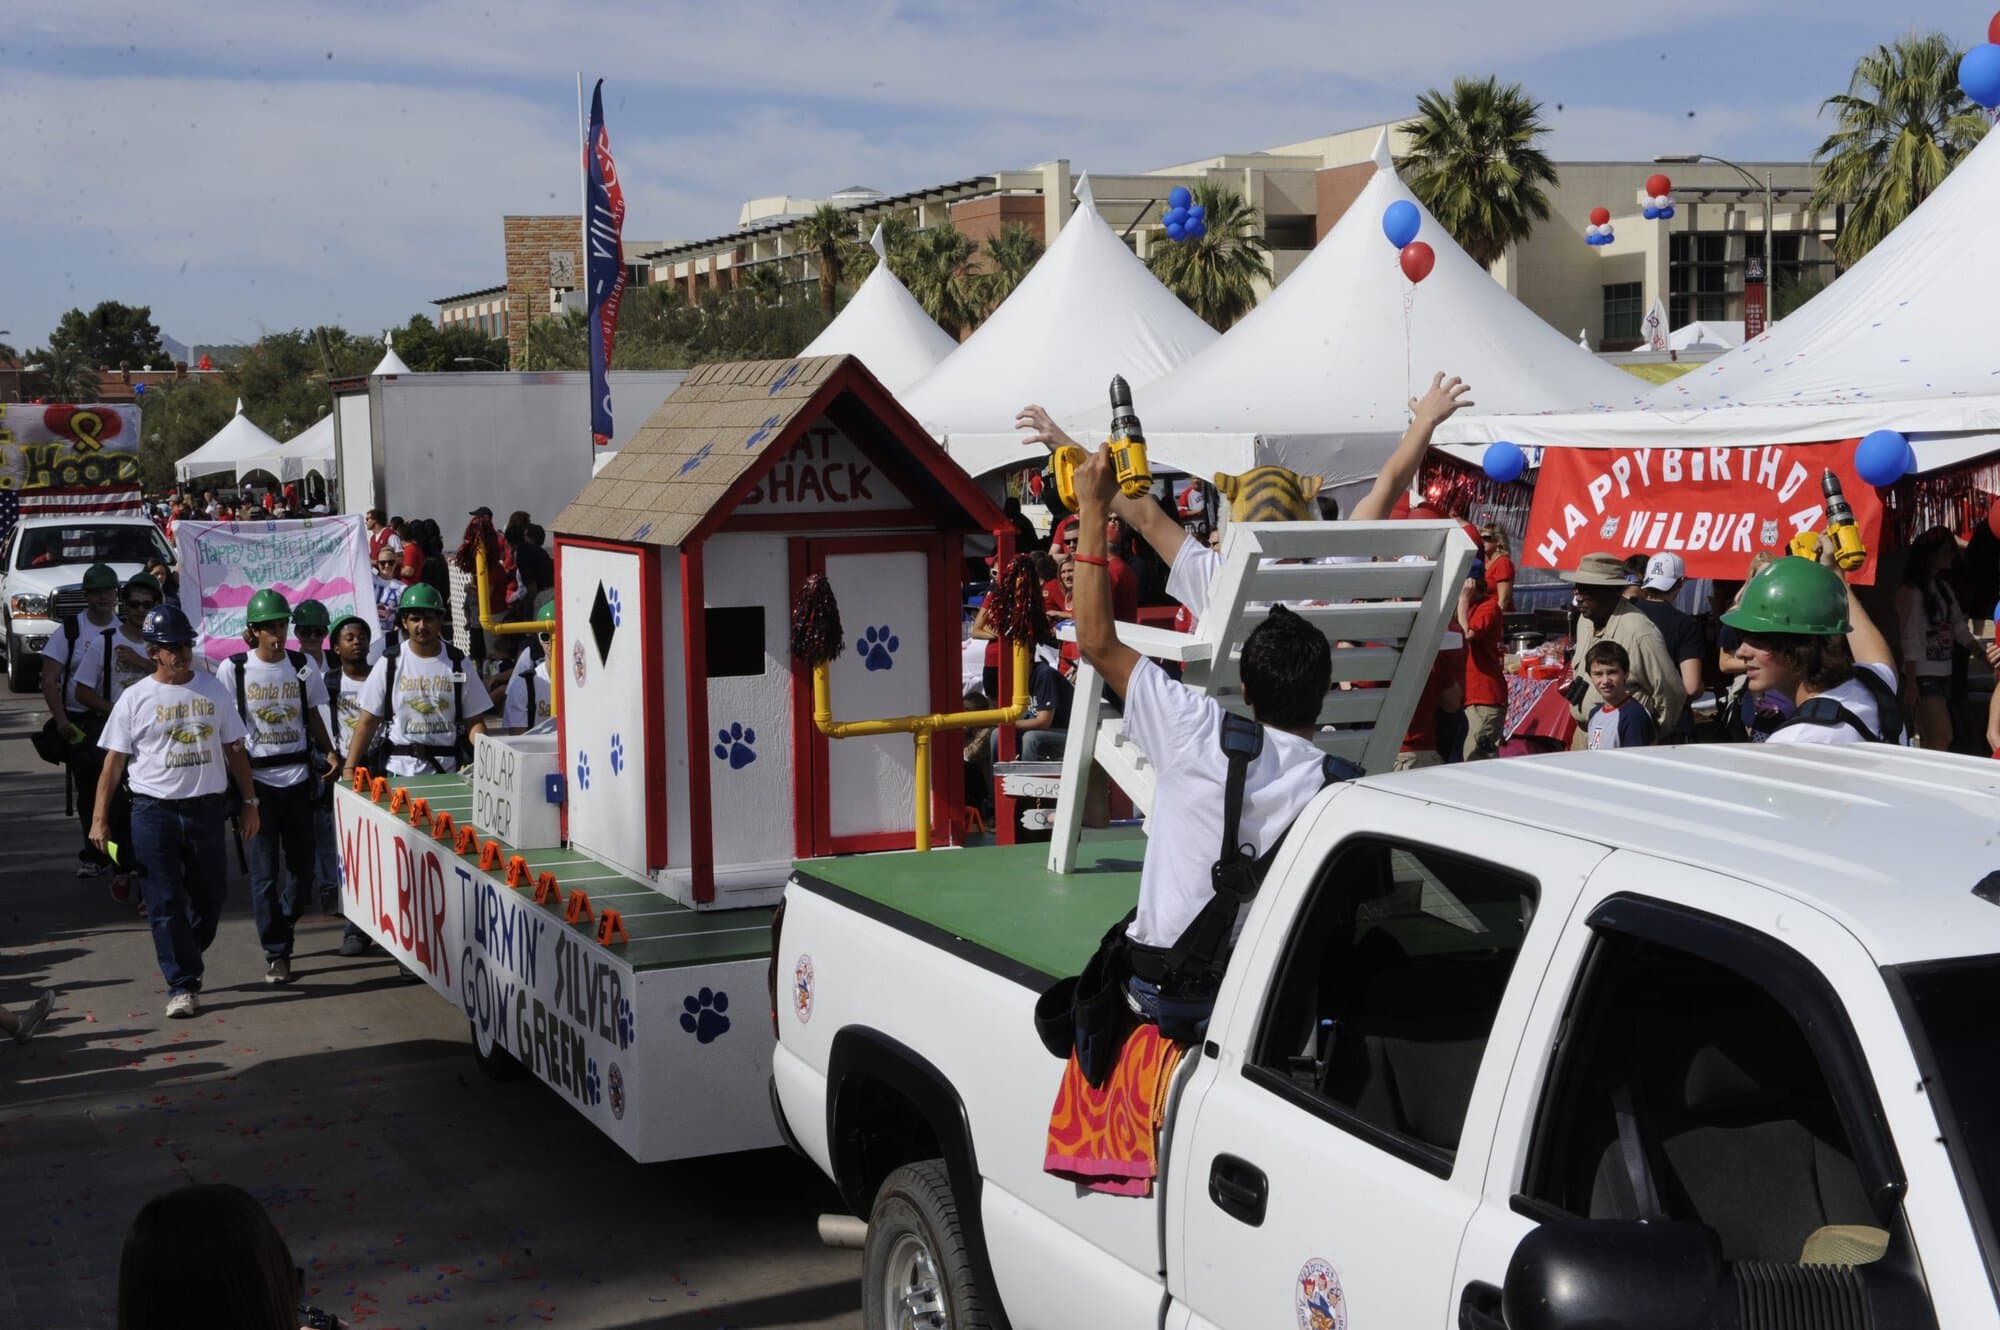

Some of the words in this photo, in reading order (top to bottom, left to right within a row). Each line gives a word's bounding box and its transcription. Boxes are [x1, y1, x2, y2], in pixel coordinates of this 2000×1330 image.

[778, 428, 838, 461] AT
[1537, 447, 1651, 567] HAPPY
[1663, 446, 1824, 532] BIRTHDA
[247, 682, 279, 700] Santa
[400, 674, 431, 692] Santa
[156, 700, 189, 724] Santa
[192, 697, 215, 716] Rita
[478, 740, 515, 793] SOLAR
[477, 789, 512, 838] POWER
[336, 796, 450, 987] WILBUR
[455, 866, 545, 989] TURNIN'
[554, 930, 622, 1046] SILVER
[461, 946, 515, 1049] GOIN'
[516, 989, 589, 1106] GREEN
